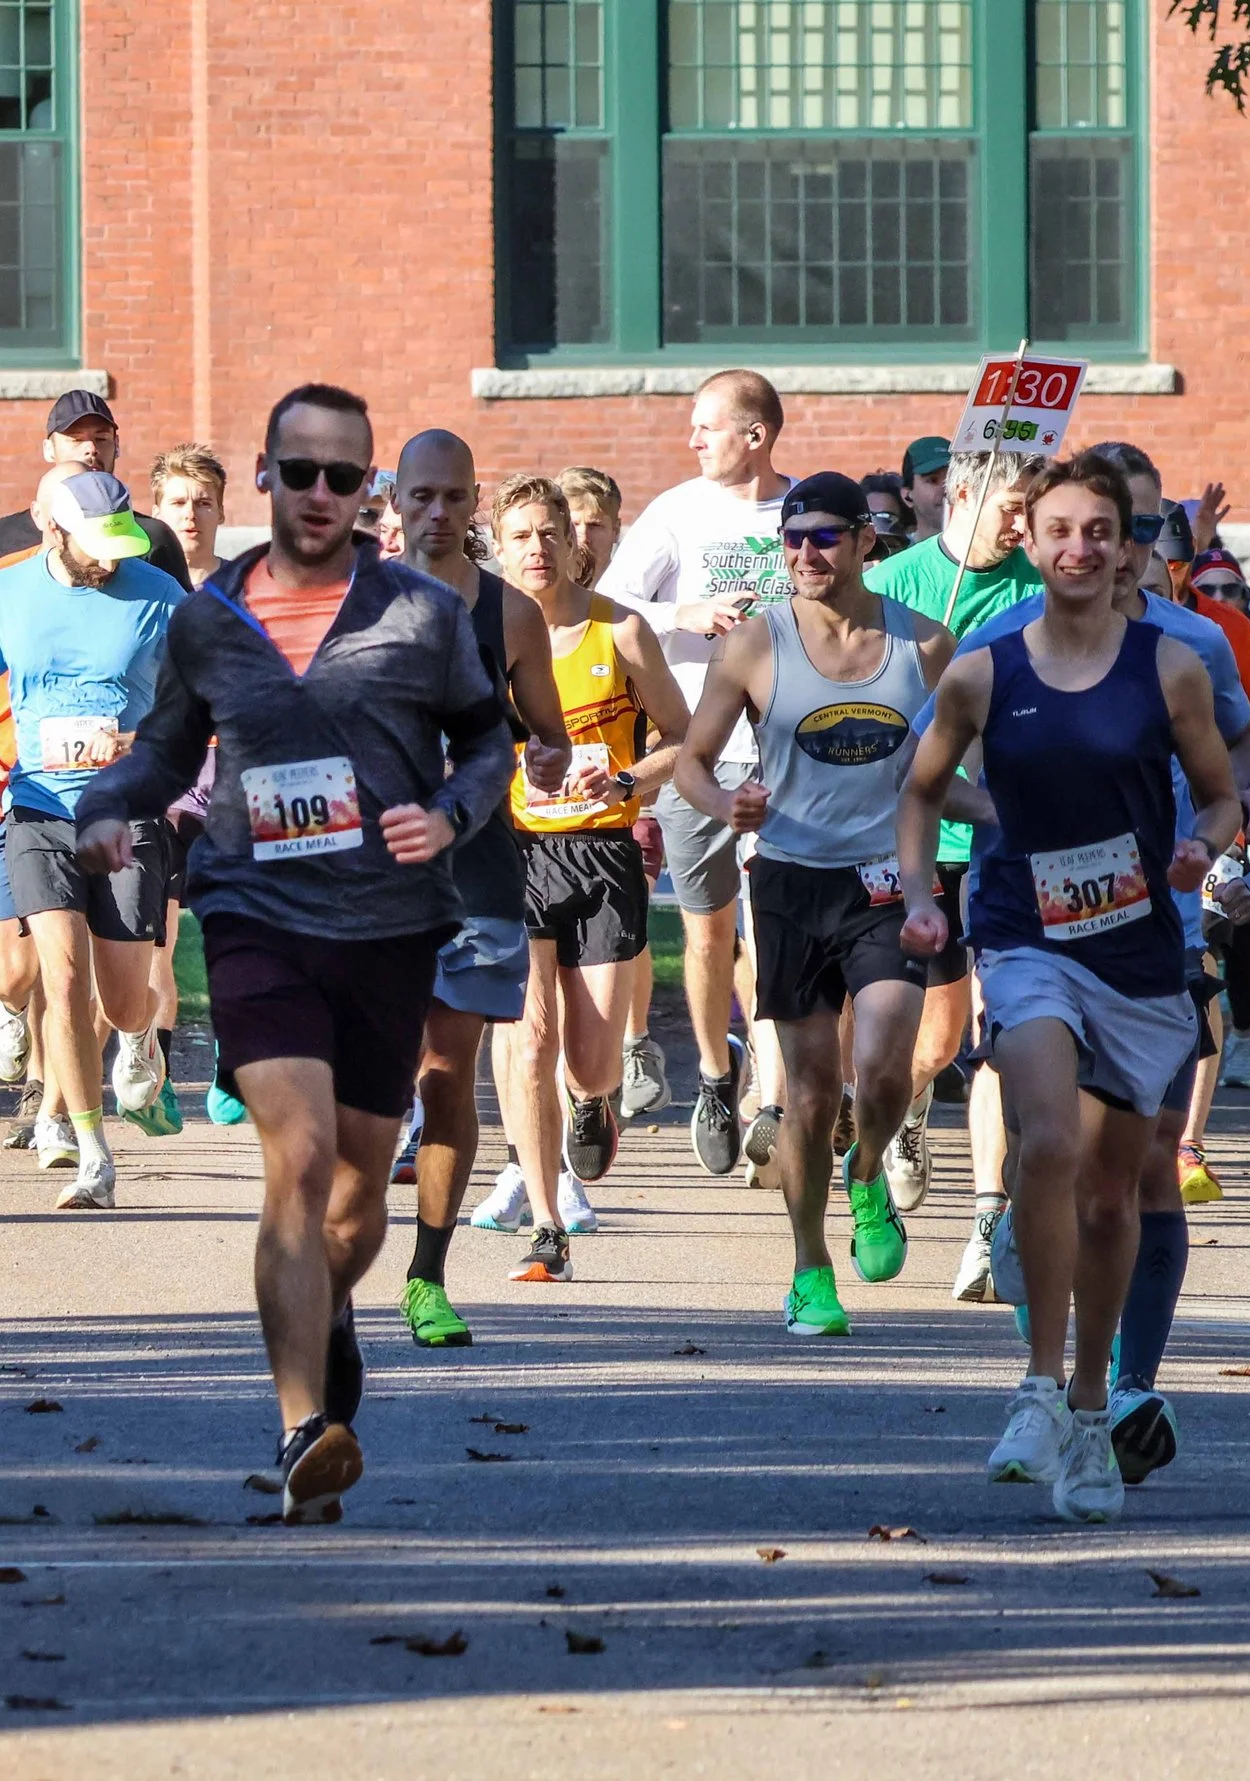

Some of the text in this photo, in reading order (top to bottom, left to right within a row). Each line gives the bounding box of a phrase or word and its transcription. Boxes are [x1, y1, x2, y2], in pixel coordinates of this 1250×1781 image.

[985, 369, 1068, 407] 1:30
[716, 541, 745, 551] 2023
[702, 553, 769, 569] Southern
[709, 577, 757, 593] Spring
[813, 708, 893, 722] CENTRAL VERMONT
[828, 743, 877, 757] RUNNERS
[274, 794, 330, 830] 109
[545, 807, 568, 815] RACE
[275, 837, 338, 853] RACE MEAL
[1063, 872, 1115, 913] 307
[1068, 910, 1131, 935] RACE MEAL
